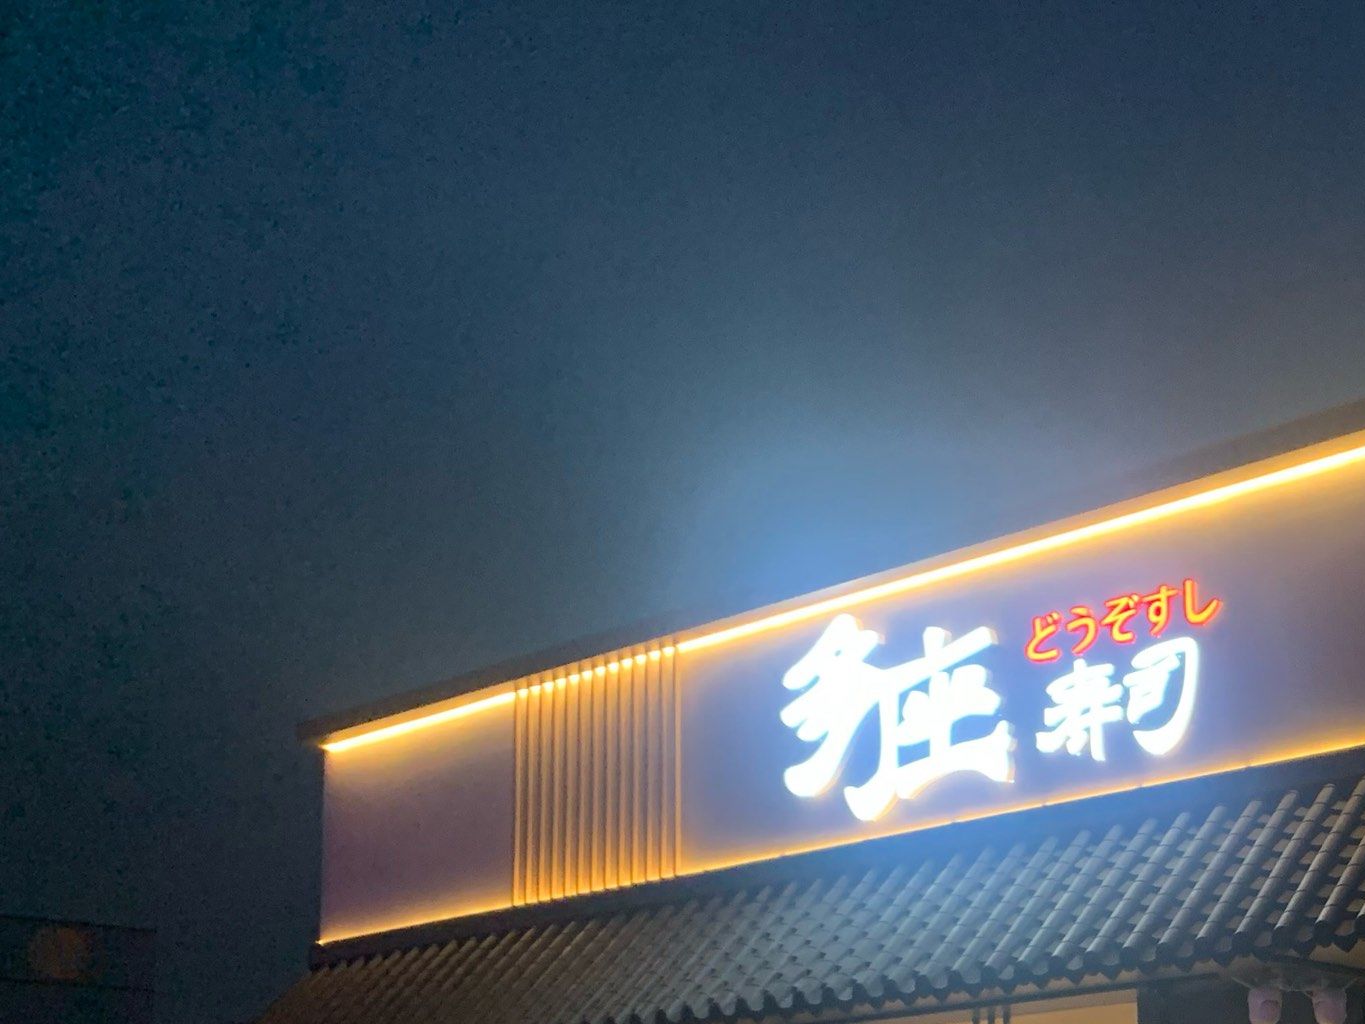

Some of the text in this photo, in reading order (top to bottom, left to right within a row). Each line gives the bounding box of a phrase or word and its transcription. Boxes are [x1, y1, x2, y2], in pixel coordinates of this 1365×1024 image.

[1025, 578, 1223, 662] どうぞすし
